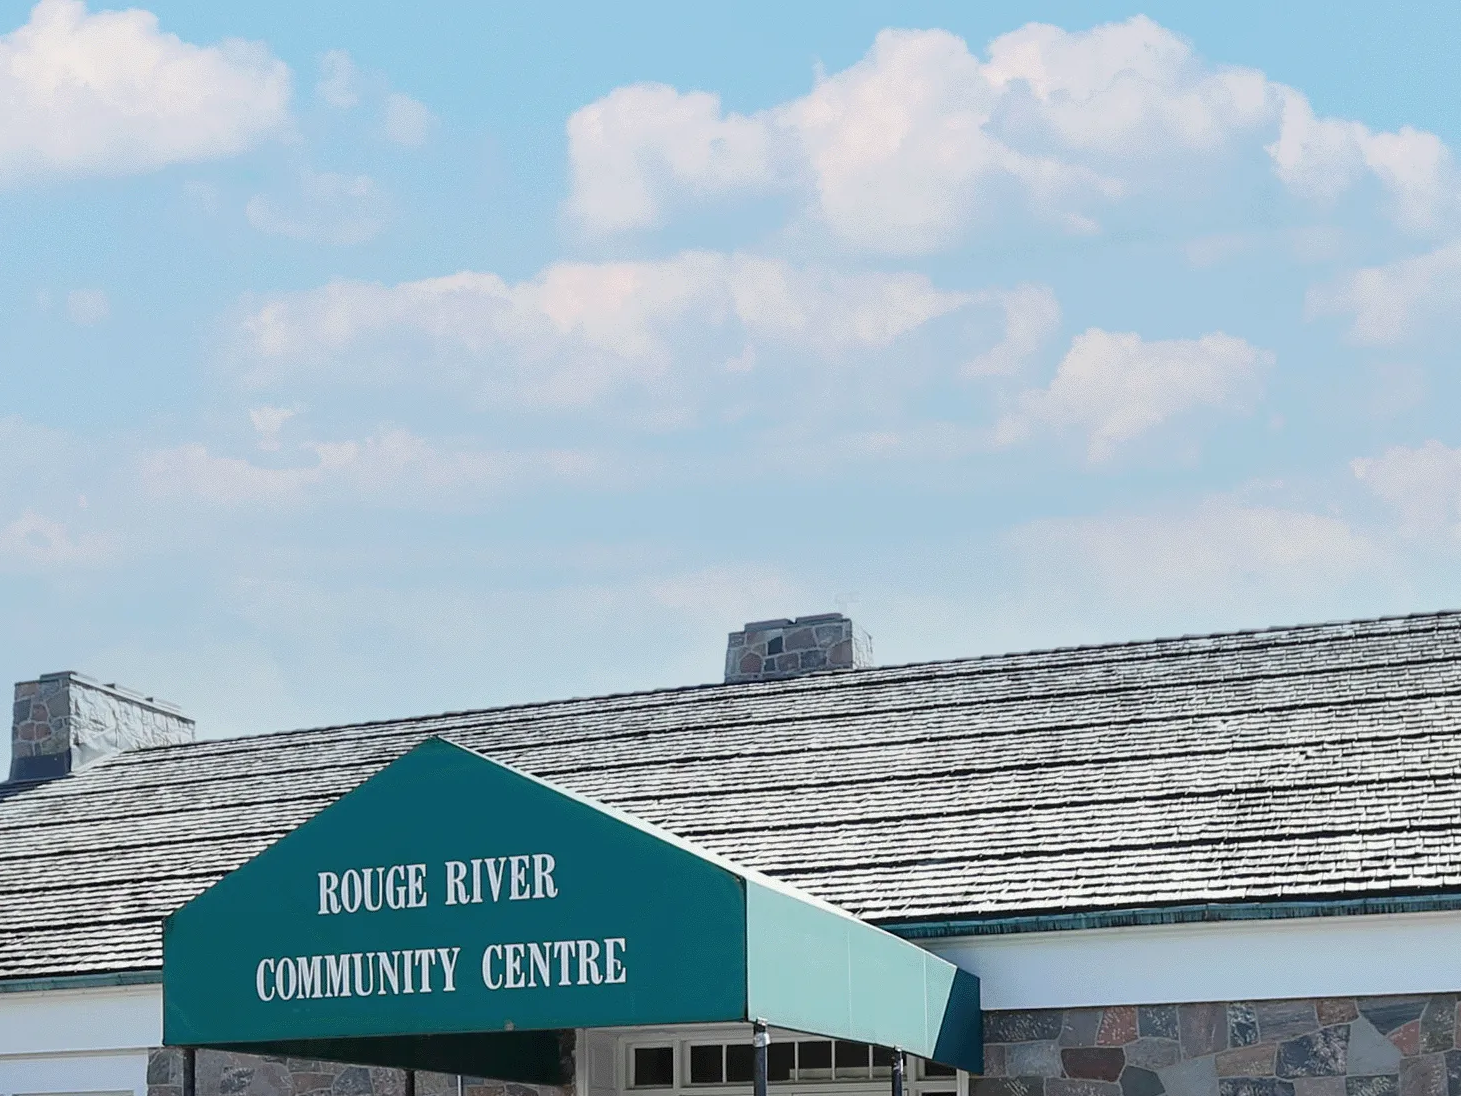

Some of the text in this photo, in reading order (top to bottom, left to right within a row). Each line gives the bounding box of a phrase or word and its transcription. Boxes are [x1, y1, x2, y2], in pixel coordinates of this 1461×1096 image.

[317, 854, 559, 915] ROUGE RIVER
[256, 938, 626, 1002] COMMUNITY CENTRE
